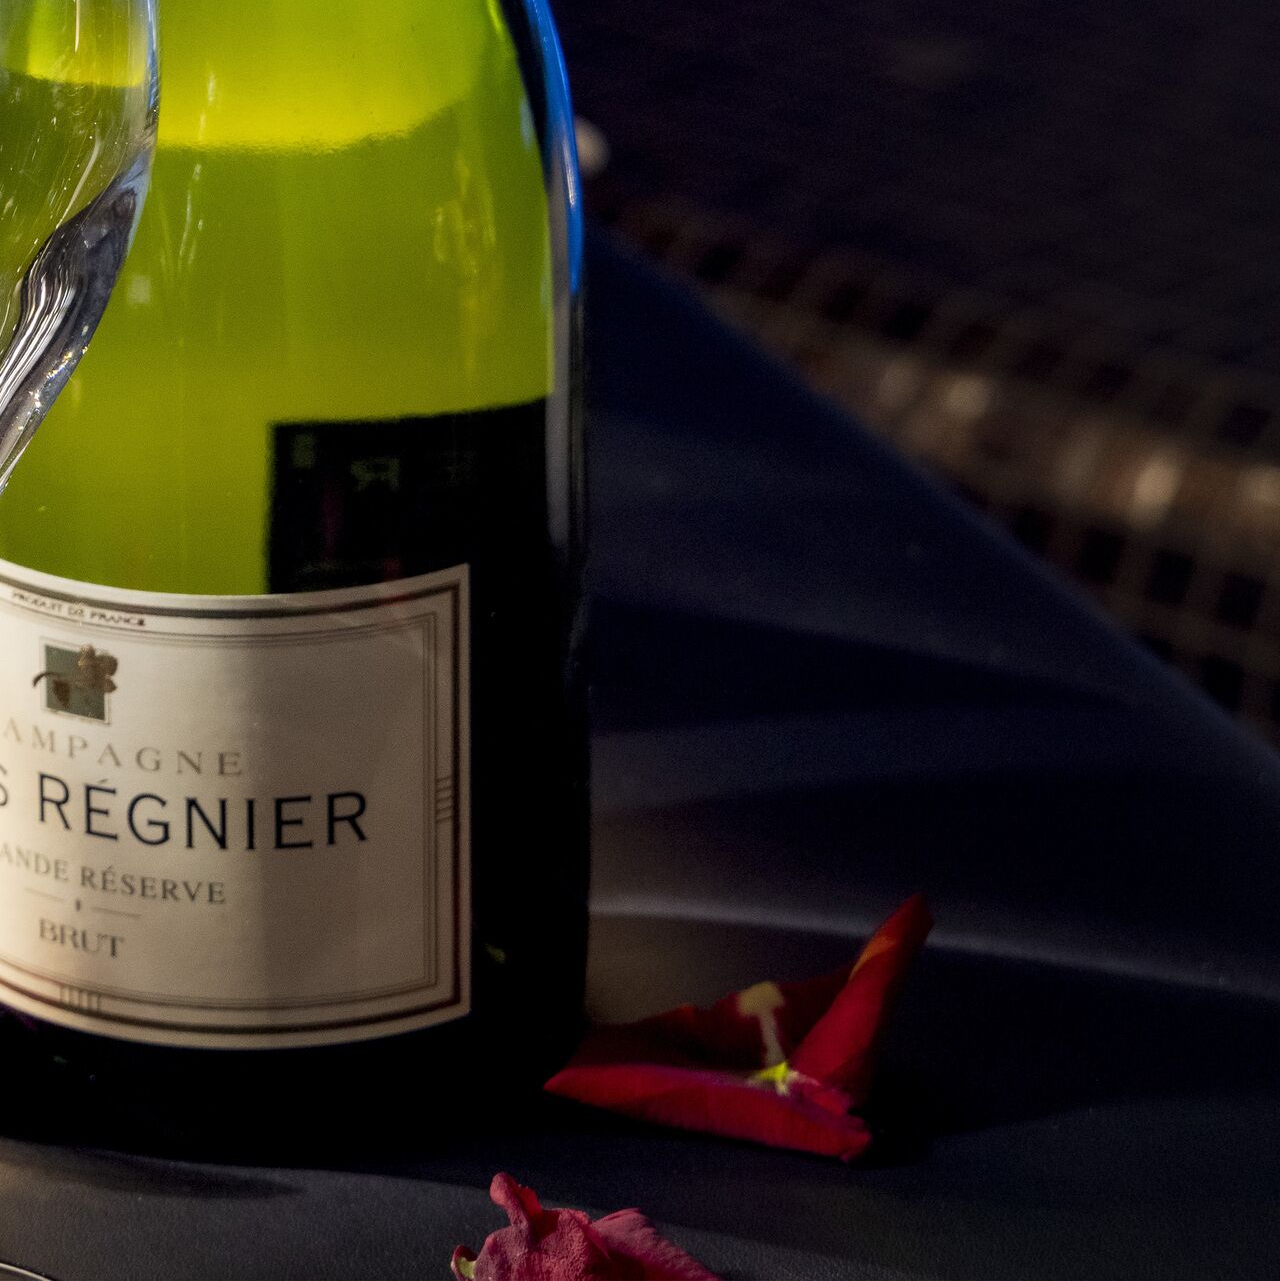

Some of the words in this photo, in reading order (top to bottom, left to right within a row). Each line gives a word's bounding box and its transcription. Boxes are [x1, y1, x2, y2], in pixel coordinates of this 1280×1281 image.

[38, 771, 368, 851] RÉGNIER
[80, 866, 227, 905] RÉSERVE
[39, 917, 125, 959] BRUT
